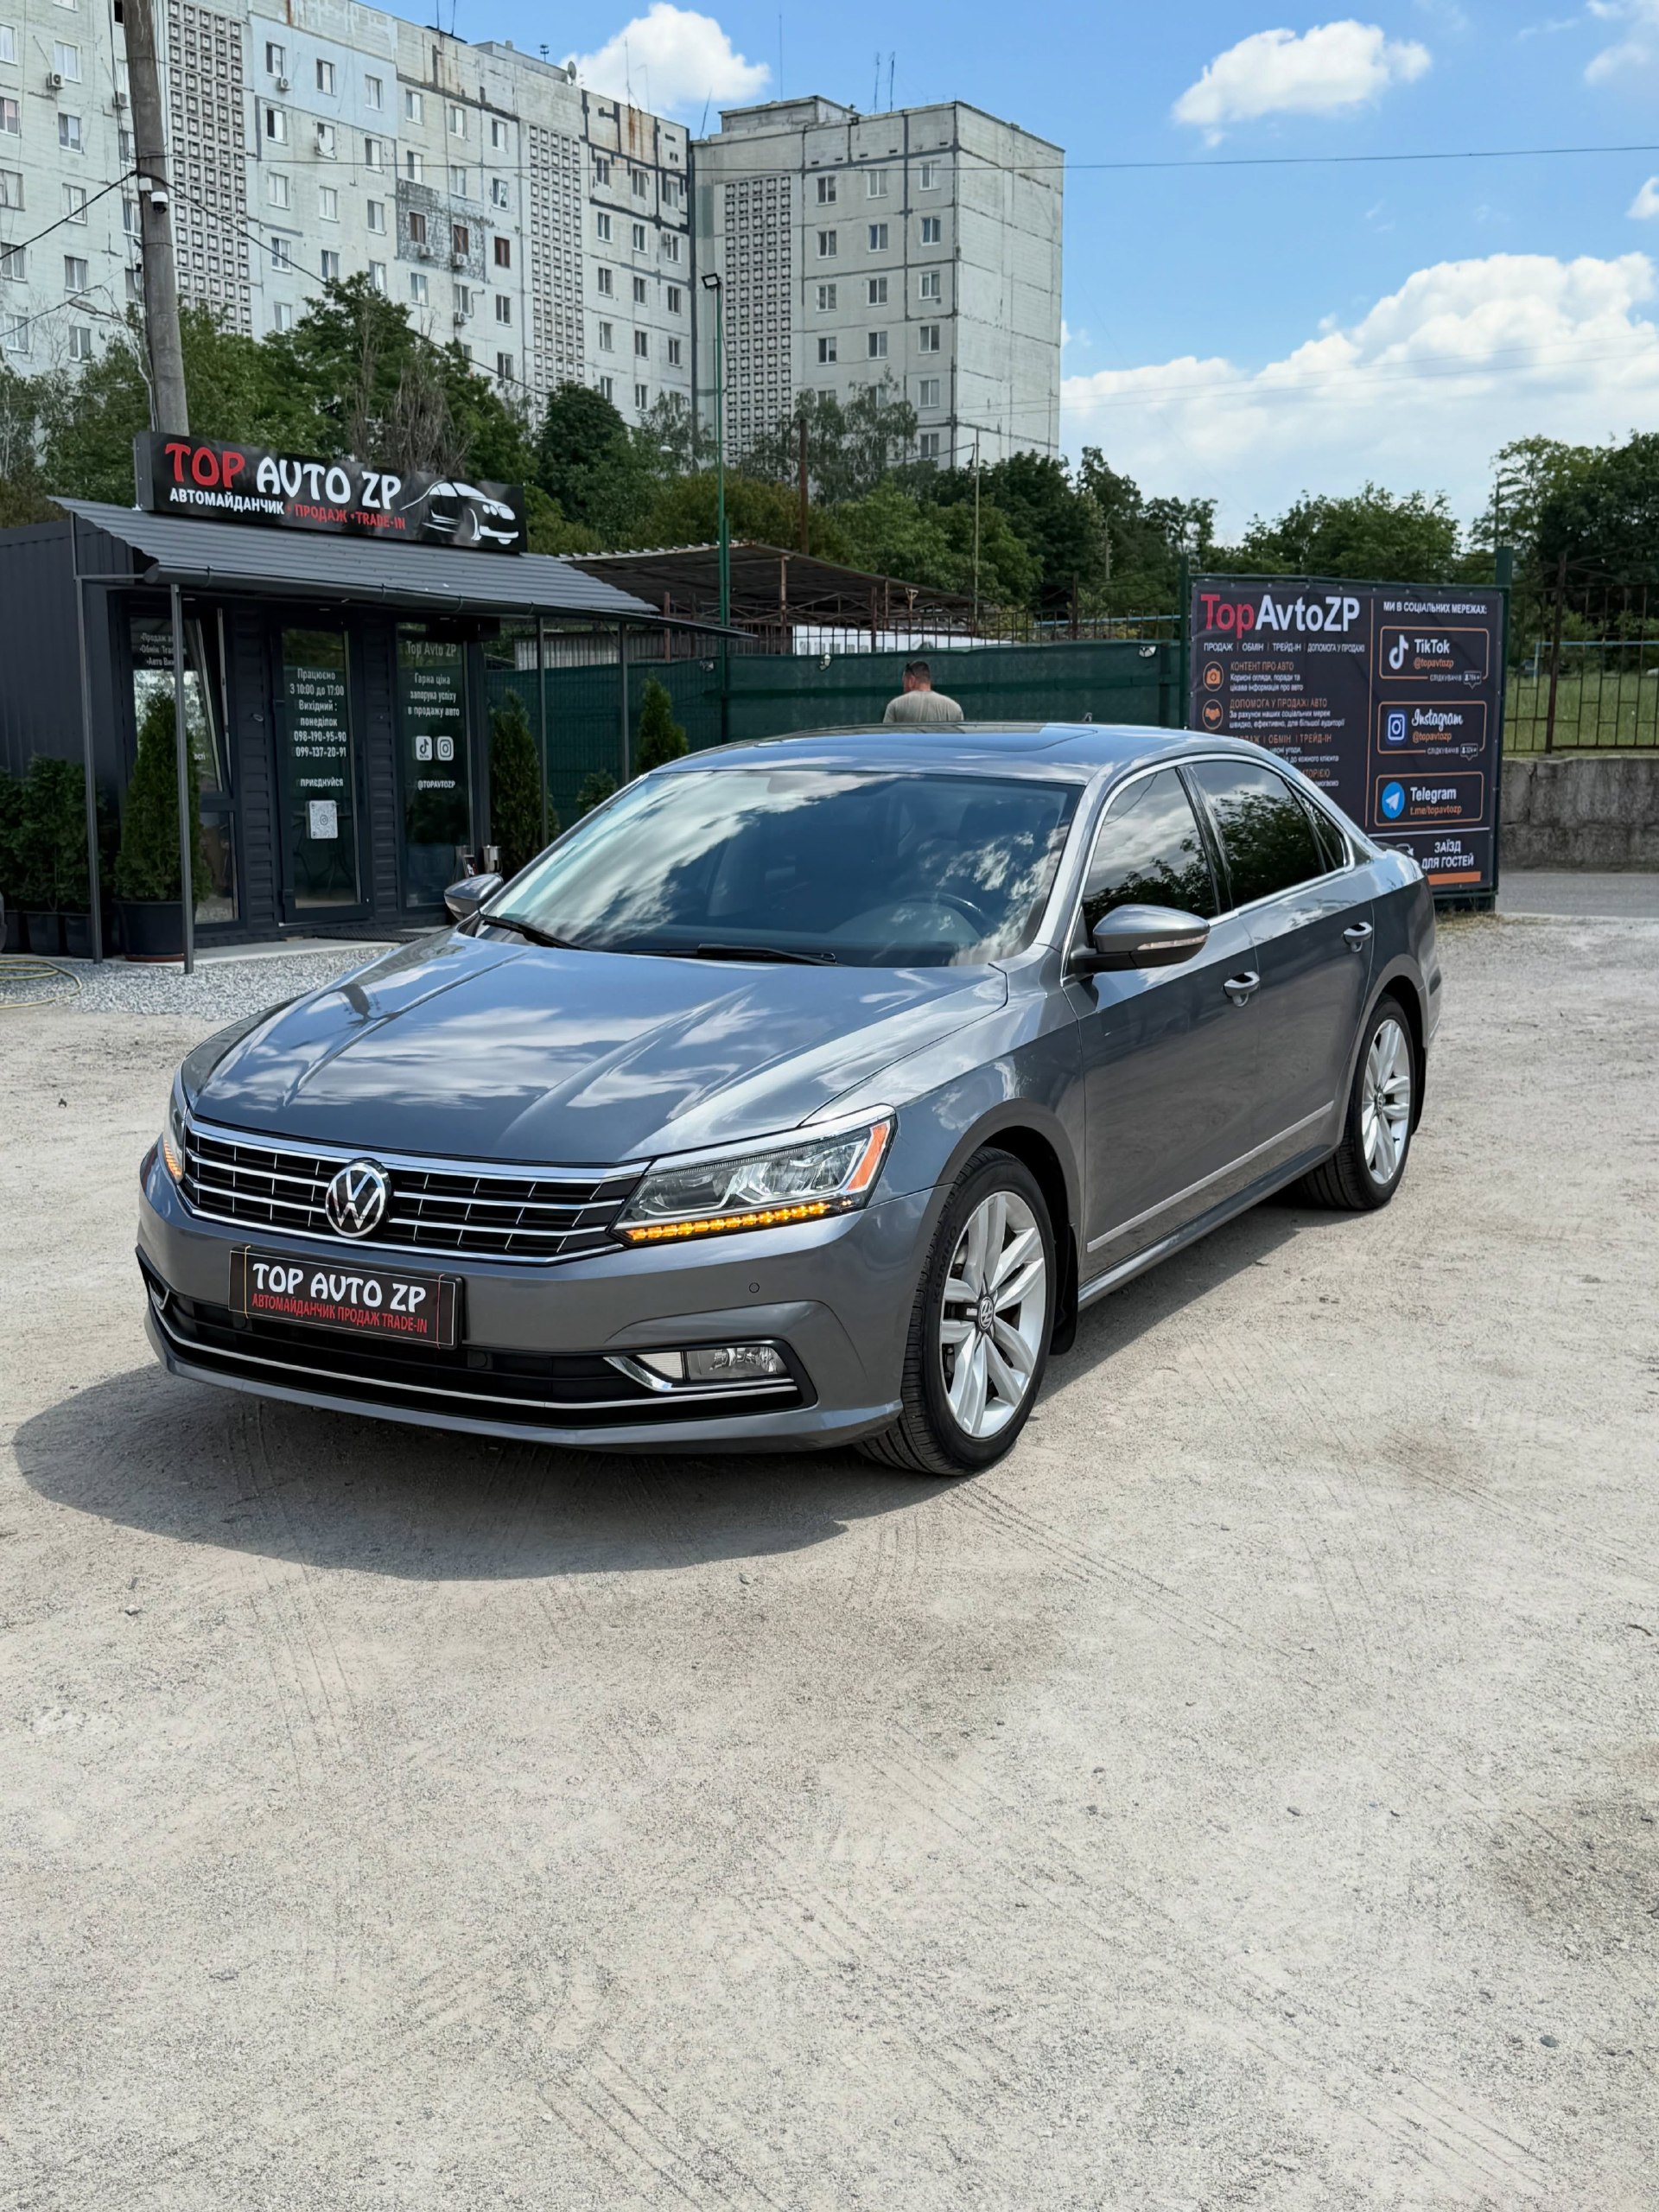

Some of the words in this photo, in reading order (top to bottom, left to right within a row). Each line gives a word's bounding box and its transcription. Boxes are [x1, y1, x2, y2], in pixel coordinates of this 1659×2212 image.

[165, 442, 245, 488] TOP
[257, 455, 352, 505] AVTO
[360, 470, 402, 510] ZP
[169, 486, 285, 516] АВТОМАЙДАНЧИК
[295, 503, 347, 524] ПРОДАЖ
[1383, 601, 1395, 612] МИ
[1396, 601, 1402, 612] В
[1403, 601, 1451, 613] СОЦІАЛЬНИХ
[1452, 603, 1488, 614] МЕРЕЖАХ:
[406, 640, 422, 658] Top
[424, 642, 443, 657] Avto
[446, 643, 457, 658] ZP
[1204, 642, 1234, 652] ПРОДАЖ
[1242, 642, 1264, 652] ОБМІН
[1414, 639, 1450, 654] TikTok
[1230, 661, 1262, 671] КОНТЕНТ
[1262, 661, 1277, 671] ПРО
[1277, 661, 1294, 671] АВТО
[297, 668, 336, 681] Працюємо
[414, 673, 435, 685] Гарна
[435, 673, 450, 685] ціна
[296, 683, 315, 696] 10:00
[316, 687, 326, 696] до
[327, 685, 345, 696] 17:00
[299, 700, 334, 712] Вихідний
[1230, 698, 1270, 709] ДОПОМОГА
[1270, 698, 1276, 708] У
[1277, 698, 1309, 709] ПРОДАЖІ
[1309, 698, 1327, 708] АВТО
[414, 707, 443, 718] продажу
[445, 708, 460, 716] авто
[300, 715, 338, 728] понеділок
[1411, 709, 1464, 732] Instagram
[294, 731, 346, 742] 098-190-95-90
[1268, 734, 1292, 744] ОБМІН
[296, 747, 346, 757] 099-137-20-91
[1410, 786, 1457, 804] Telegram
[1434, 839, 1461, 854] ЗАЇЗД
[1421, 856, 1439, 870] ДЛЯ
[1441, 853, 1474, 868] ГОСТЕЙ
[252, 1262, 304, 1294] TOP
[310, 1272, 383, 1308] AVTO
[390, 1283, 427, 1313] ZP
[251, 1293, 336, 1320] АВТОМАЙДАНЧИК
[337, 1307, 380, 1327] ПРОДАЖ
[382, 1313, 428, 1334] TRADE-IN
